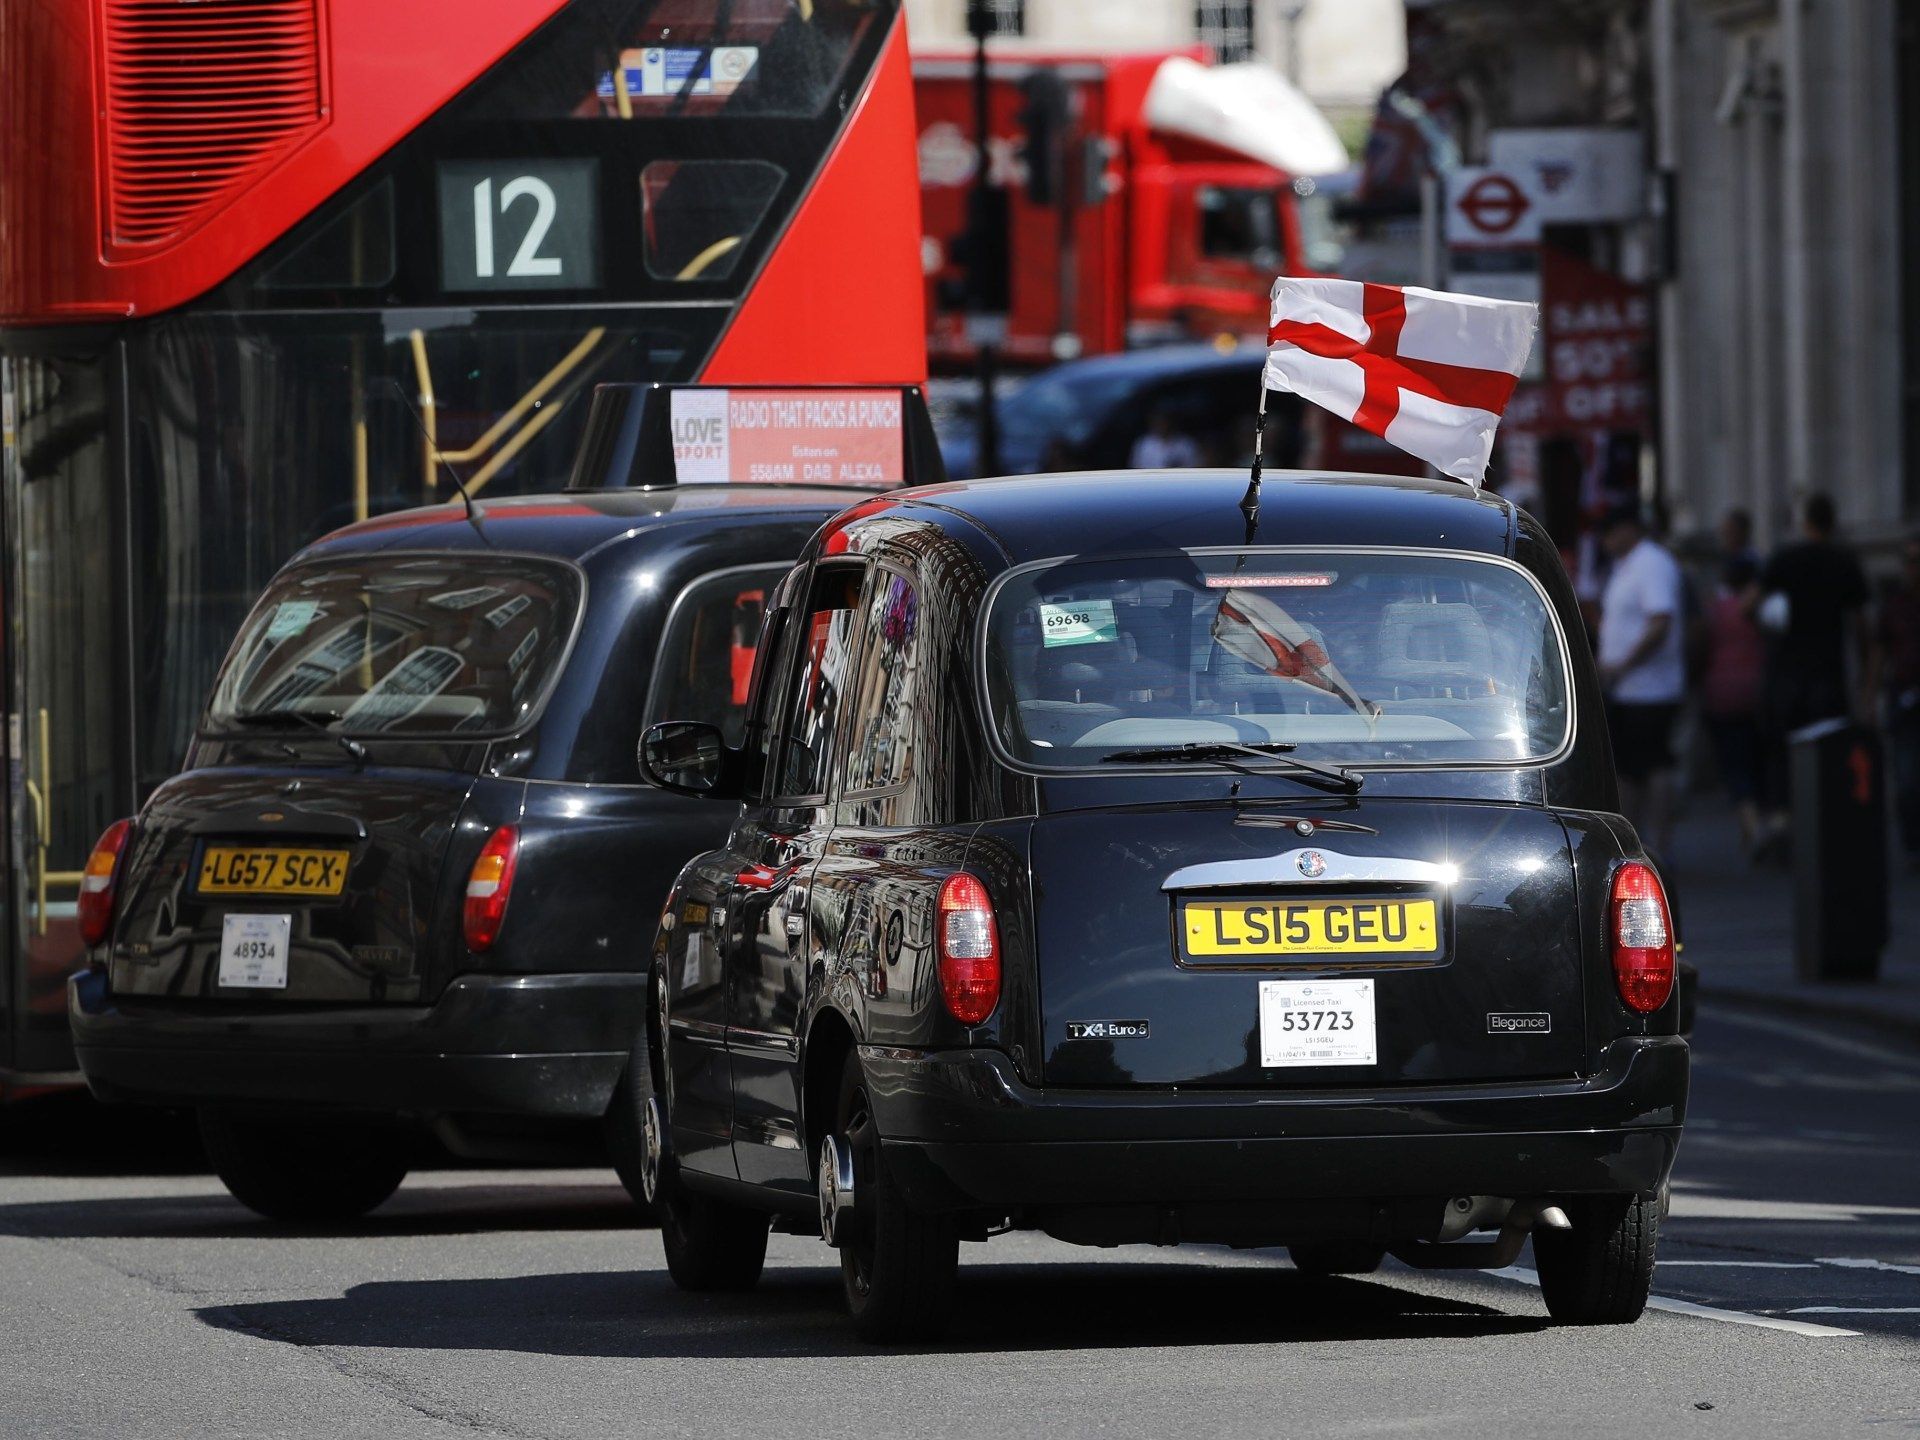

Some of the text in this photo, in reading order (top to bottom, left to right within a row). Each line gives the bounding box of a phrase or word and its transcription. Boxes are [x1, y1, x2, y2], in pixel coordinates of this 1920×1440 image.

[474, 176, 562, 278] 12
[731, 400, 900, 428] RADIO THAT PACKS A PUNCH
[675, 418, 722, 443] LOVE
[675, 447, 721, 459] SPORT
[803, 464, 832, 480] DAB
[839, 463, 883, 480] ALEXA
[1047, 613, 1090, 627] 69698
[211, 854, 337, 888] LG57 SCX
[1214, 904, 1407, 945] LS15 GEU
[233, 942, 275, 959] 48934
[1069, 1023, 1147, 1037] TX4 Euro 5
[1282, 1011, 1354, 1031] 53723
[1491, 1016, 1546, 1031] Elegance
